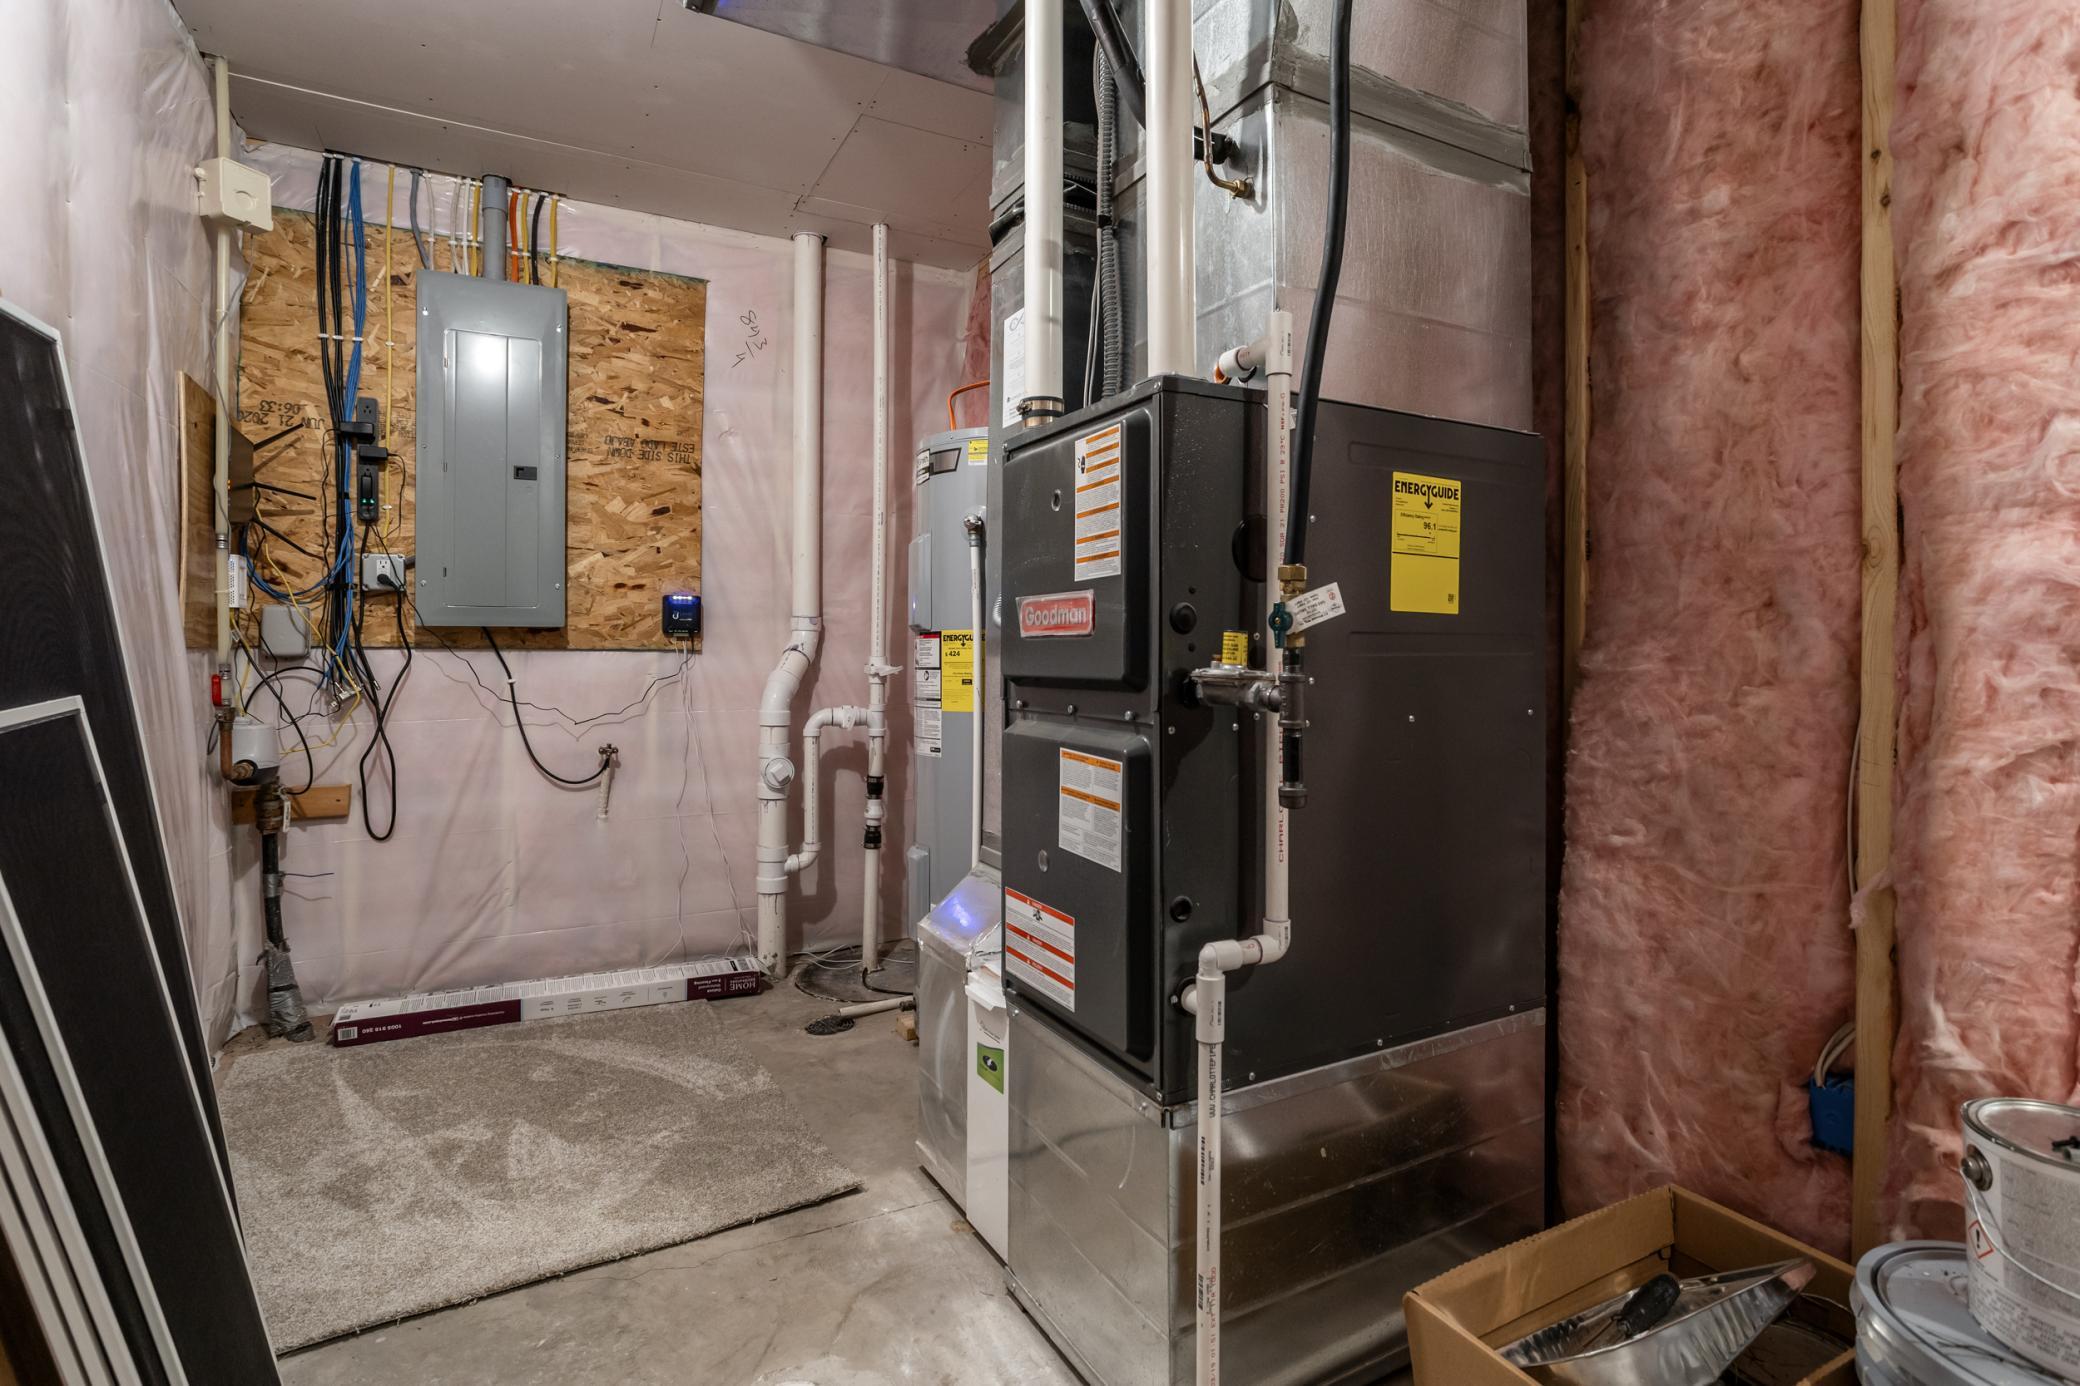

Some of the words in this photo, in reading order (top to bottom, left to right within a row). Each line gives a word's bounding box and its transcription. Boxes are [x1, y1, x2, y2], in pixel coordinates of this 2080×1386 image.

[259, 400, 301, 414] 06:33
[280, 414, 293, 427] 21
[607, 447, 634, 458] DOWN
[671, 442, 695, 453] ESTE
[638, 450, 662, 461] SIDE
[667, 452, 691, 464] THIS
[1394, 480, 1459, 500] ENERGYGUIDE
[1025, 604, 1086, 626] Goodman
[729, 981, 756, 990] HOME
